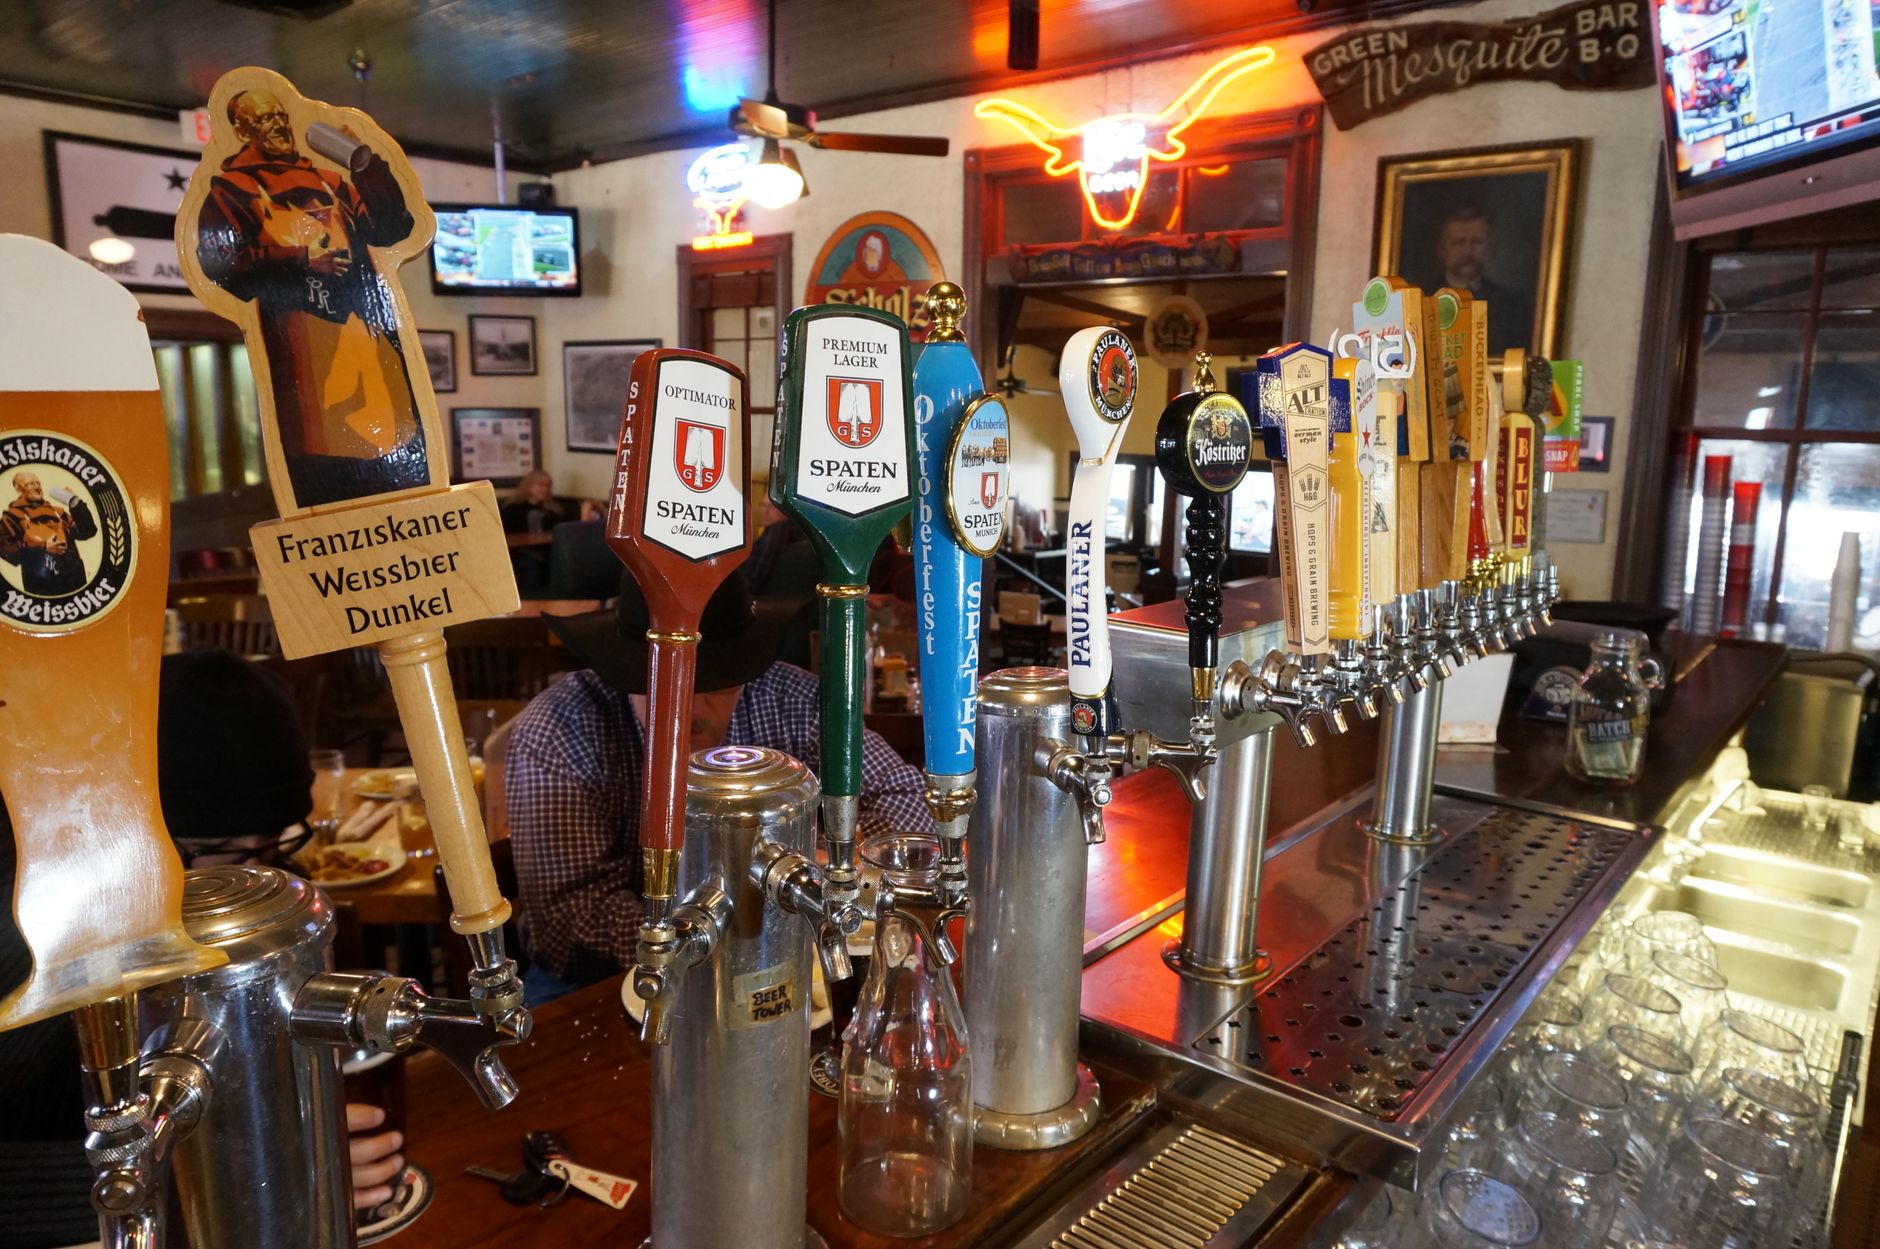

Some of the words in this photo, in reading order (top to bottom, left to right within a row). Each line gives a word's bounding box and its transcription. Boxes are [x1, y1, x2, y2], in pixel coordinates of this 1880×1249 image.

[1576, 3, 1639, 35] BAR
[1312, 30, 1408, 75] GREEN
[1336, 24, 1569, 109] Mesquite
[822, 338, 888, 355] PREMIUM
[833, 354, 879, 368] LAGER
[1093, 334, 1137, 368] PAULANER
[1475, 321, 1485, 417] BUCKETHEAD
[665, 384, 736, 411] OPTIMATOR
[772, 337, 788, 468] SPATEN
[1287, 384, 1324, 414] ALT
[970, 418, 1006, 431] Oktoberfes
[614, 381, 639, 511] SPATEN
[1545, 450, 1569, 462] SNAP
[809, 459, 899, 479] SPATEN
[826, 480, 882, 494] München
[1513, 437, 1529, 536] BLUR
[656, 500, 736, 526] SPATEN
[913, 393, 935, 655] Oktoberfest
[276, 507, 472, 564] Franziskaner
[670, 522, 720, 540] München
[975, 528, 998, 538] MUNICH
[1307, 523, 1316, 547] HOPS
[309, 550, 461, 599] Weissbier
[1308, 557, 1317, 586] GRAIN
[1, 577, 116, 623] Weissbier
[1071, 519, 1092, 669] PAULANER
[1310, 589, 1319, 626] BREWING
[344, 587, 454, 635] Dunkel
[955, 581, 981, 755] SPATEN
[1587, 720, 1631, 737] BATCH
[752, 985, 787, 1006] BEER
[752, 1000, 792, 1021] TOWER
